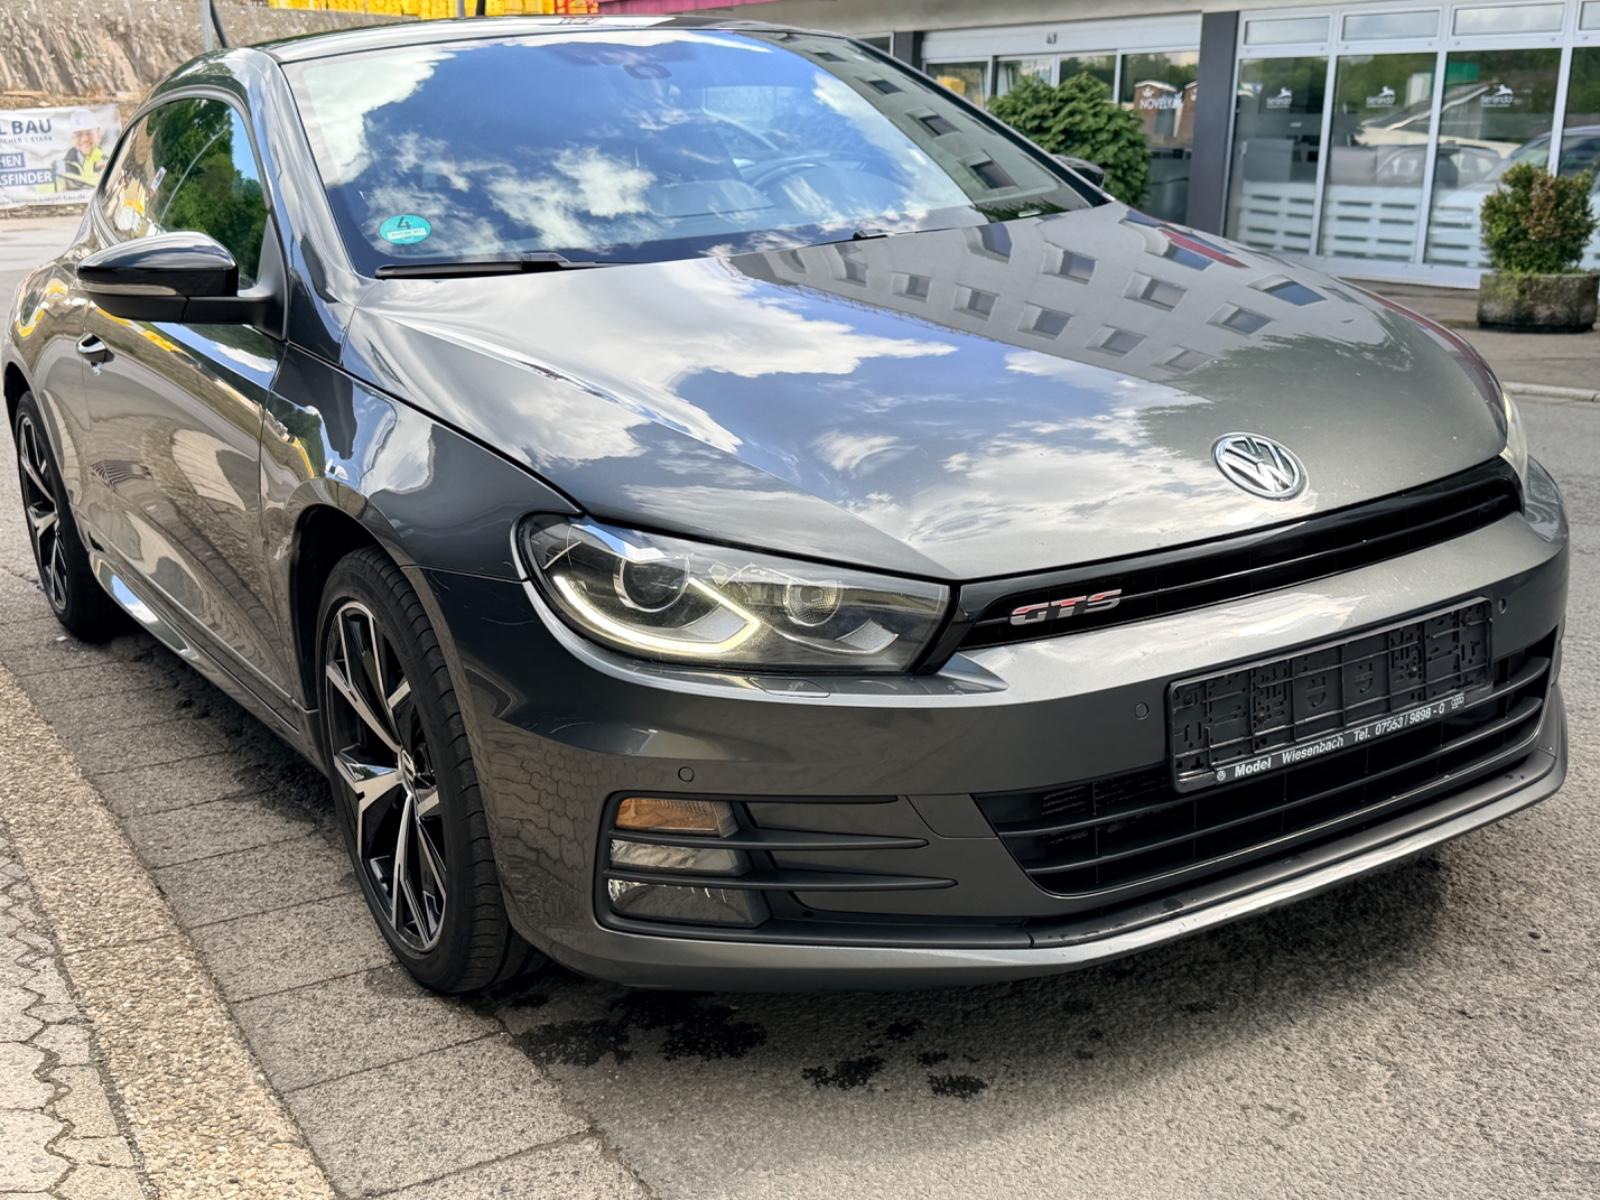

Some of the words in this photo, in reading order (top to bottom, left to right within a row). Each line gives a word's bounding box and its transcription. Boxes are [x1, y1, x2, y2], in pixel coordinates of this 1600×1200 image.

[11, 118, 52, 135] BAU
[0, 171, 53, 186] SFINDER
[397, 216, 411, 229] 4
[1214, 434, 1302, 498] VW
[1010, 589, 1122, 625] GTS
[1234, 757, 1272, 778] Model
[1282, 736, 1344, 764] Wiesenbach
[1354, 726, 1371, 742] Tel.
